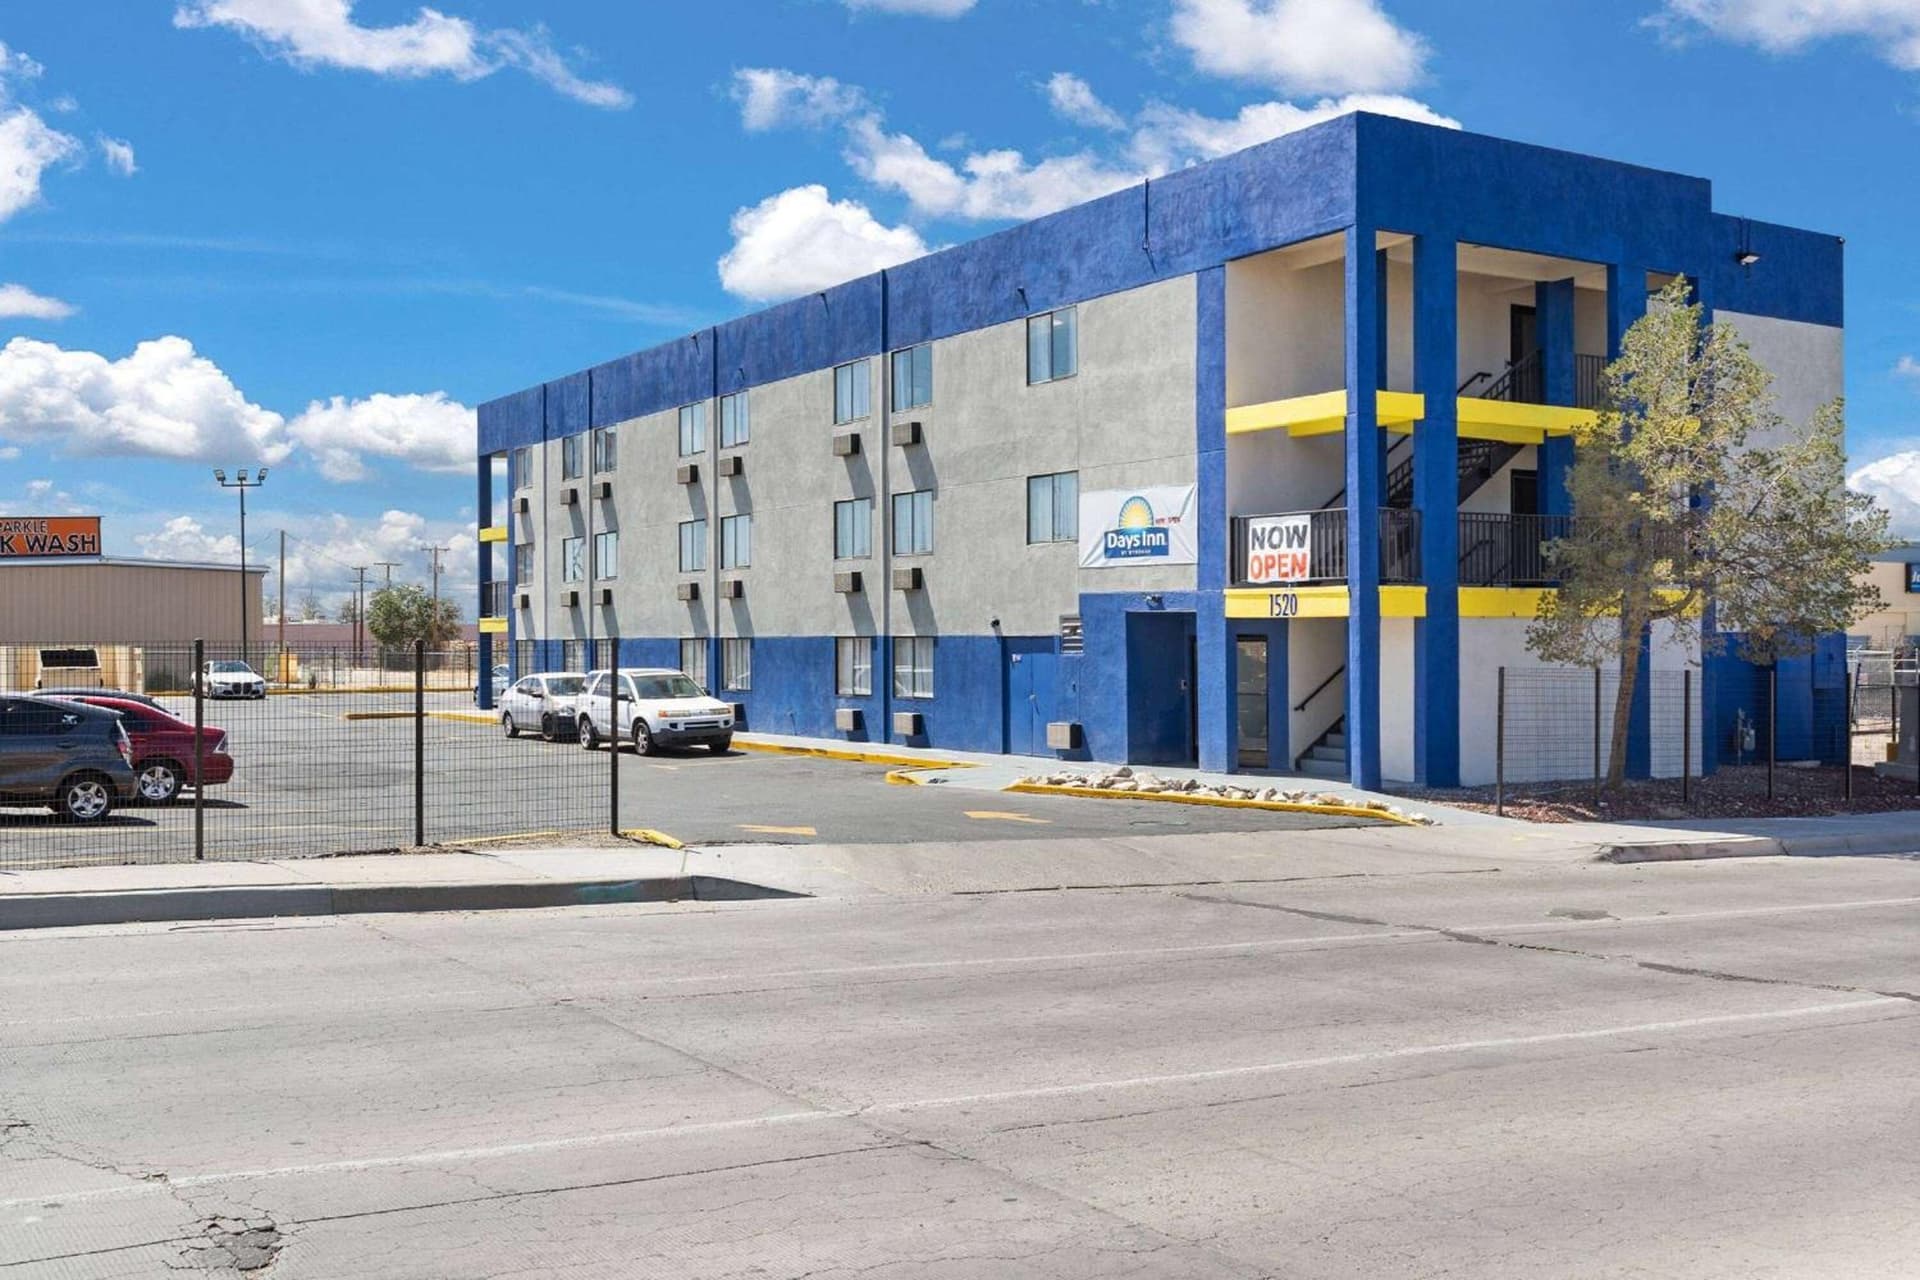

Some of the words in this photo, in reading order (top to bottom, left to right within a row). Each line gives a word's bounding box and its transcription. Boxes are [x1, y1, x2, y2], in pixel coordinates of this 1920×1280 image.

[26, 534, 96, 553] WASH
[1107, 532, 1140, 549] Days
[1142, 531, 1166, 546] Inn
[1251, 525, 1308, 550] NOW
[1250, 553, 1307, 579] OPEN
[1269, 594, 1298, 616] 1520
